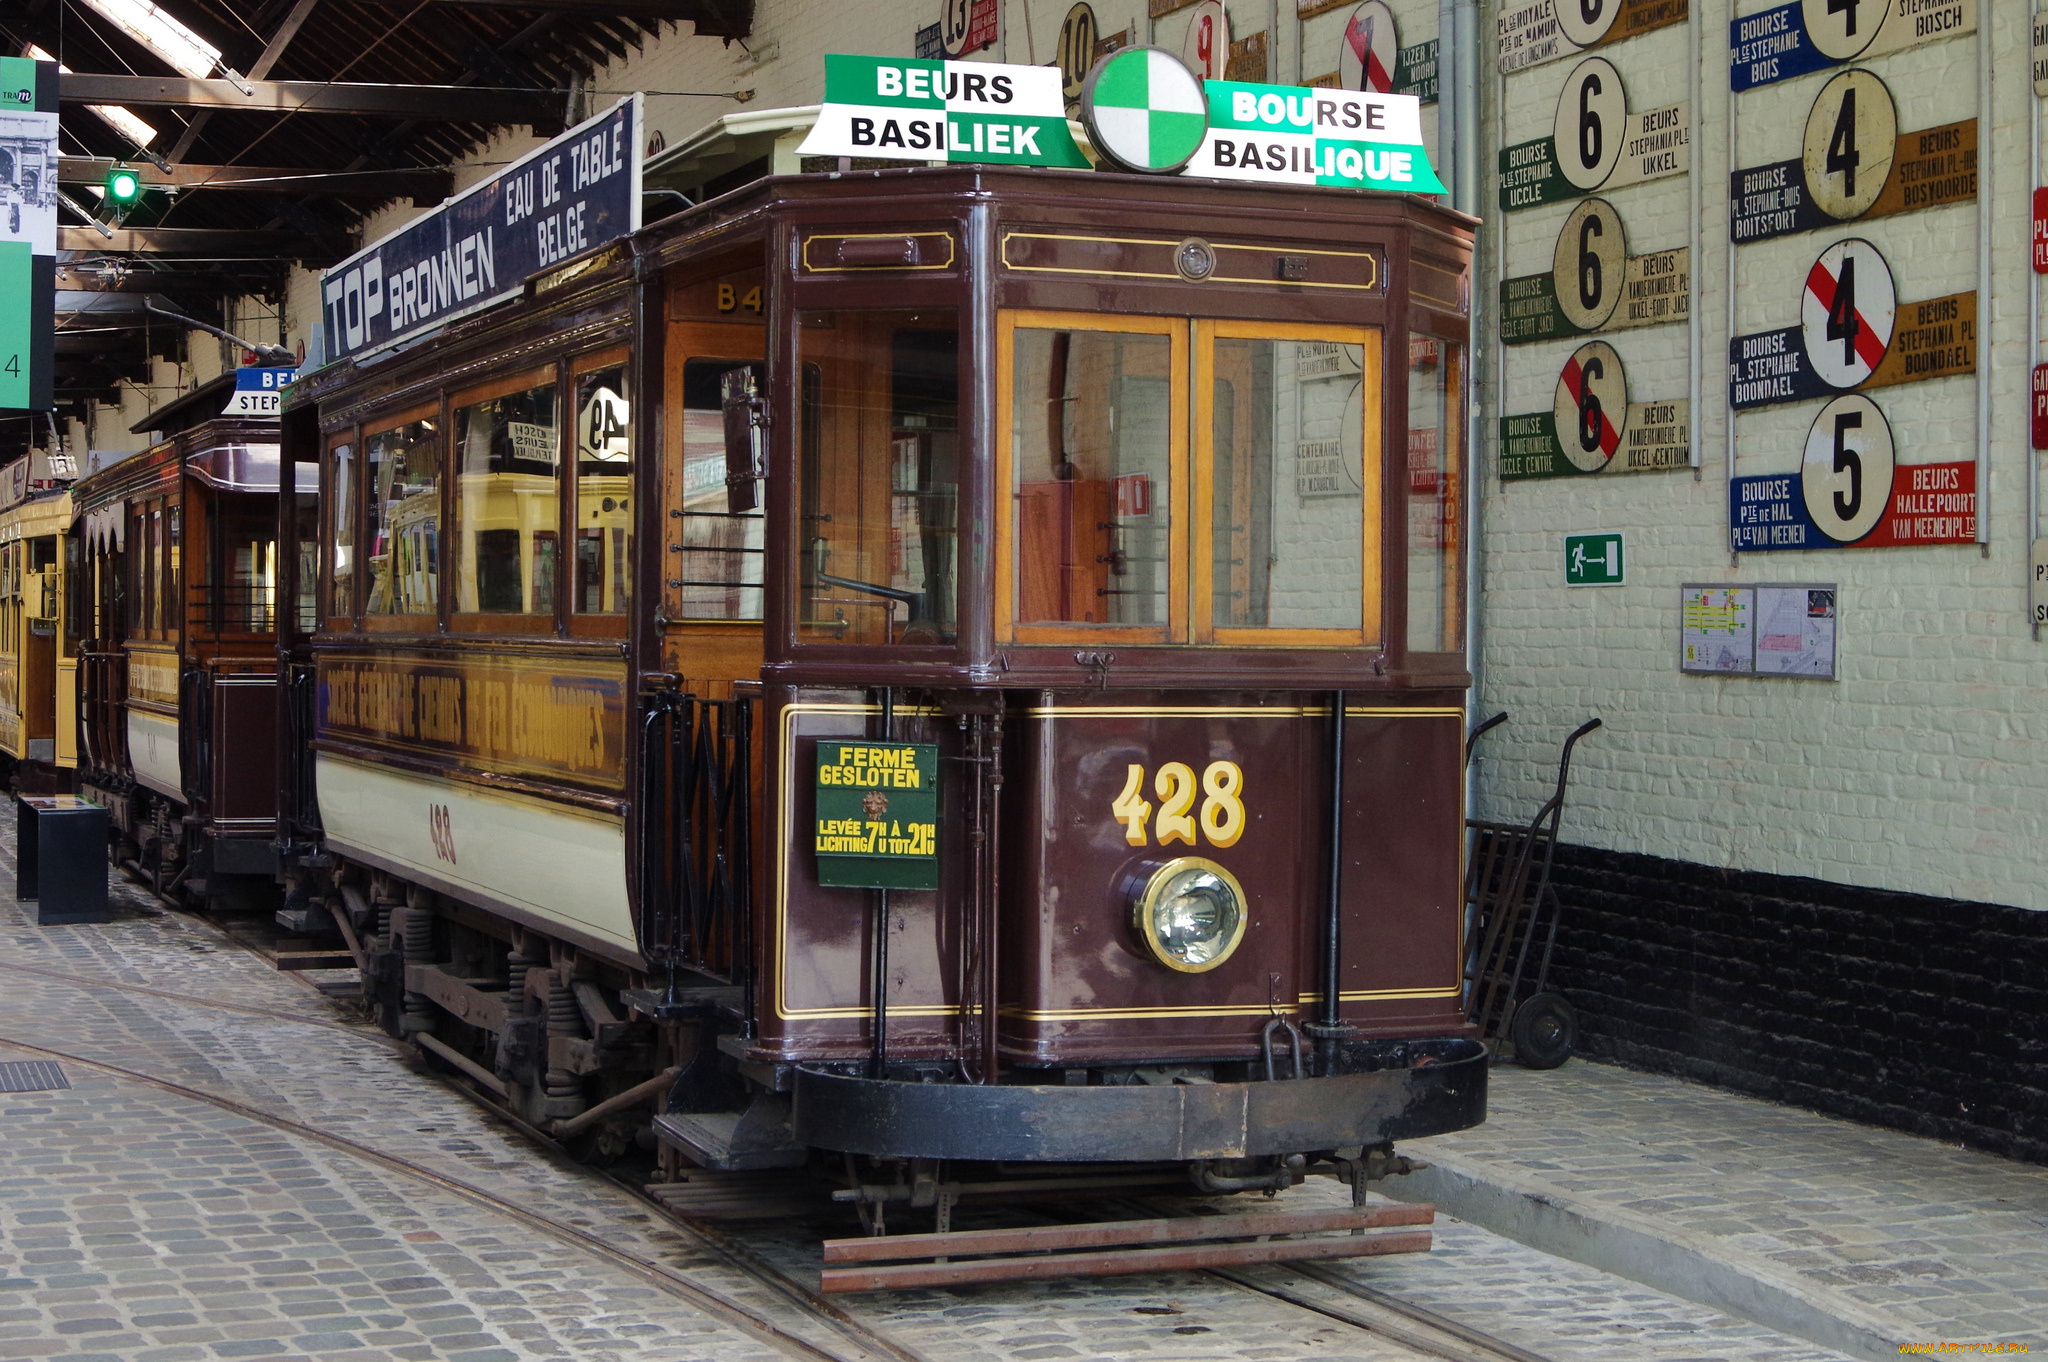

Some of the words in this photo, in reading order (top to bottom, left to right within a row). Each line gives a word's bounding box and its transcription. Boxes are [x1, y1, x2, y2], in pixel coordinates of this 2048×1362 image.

[1517, 1, 1551, 28] ROYALE
[1740, 10, 1789, 42] BOURSE
[1916, 6, 1962, 37] BOSCH
[1514, 34, 1523, 48] DE
[1526, 18, 1556, 44] NAMUR
[1751, 29, 1800, 60] STEPHANIE
[1062, 12, 1089, 88] 10
[1197, 14, 1213, 80] 9
[1357, 15, 1375, 92] 7
[1411, 61, 1436, 83] NOORD
[1751, 58, 1779, 84] BOIS
[876, 66, 1014, 104] BEURS
[1232, 90, 1386, 130] BOURSE
[1579, 73, 1603, 170] 6
[1642, 108, 1679, 134] BEURS
[851, 117, 1042, 156] BASILIEK
[1629, 132, 1672, 157] STEPHANIA
[1827, 88, 1859, 198] 4
[1919, 128, 1960, 156] BEURS
[1214, 139, 1413, 182] BASILIQUE
[1509, 142, 1547, 168] BOURSE
[1642, 151, 1678, 176] UKKEL
[506, 169, 534, 226] EAU
[542, 155, 561, 208] DE
[570, 121, 623, 193] TABLE
[1514, 161, 1553, 186] STEPHANIE
[1744, 166, 1787, 194] BOURSE
[1900, 156, 1945, 184] STEPHANIA
[1510, 184, 1542, 207] UCCLE
[537, 200, 588, 267] BELGE
[1736, 209, 1796, 239] BOITSFORT
[1579, 214, 1603, 311] 6
[1643, 255, 1675, 276] BEURS
[389, 225, 496, 332] BRONNEN
[1508, 278, 1542, 299] BOURSE
[1629, 275, 1676, 299] VANDERKINDERE
[326, 256, 383, 357] TOP
[1826, 256, 1859, 367] 4
[1917, 299, 1958, 326] BEURS
[1743, 333, 1786, 360] BOURSE
[1900, 327, 1954, 353] STEPHANIA
[4, 354, 21, 378] 4
[1747, 351, 1800, 381] STEPHANIE
[1905, 345, 1971, 376] BOONDAEL
[1735, 377, 1794, 404] BOONDAEL
[1580, 357, 1603, 452] 6
[1644, 405, 1675, 425] BEURS
[1508, 417, 1542, 437] BOURSE
[1629, 426, 1675, 447] VANDERKINDERE
[1526, 455, 1554, 476] CENTRE
[1628, 448, 1651, 467] UKKEL
[1833, 411, 1862, 521] 5
[1742, 479, 1790, 502] BOURSE
[1913, 468, 1959, 490] BEURS
[1759, 508, 1769, 522] DE
[1771, 503, 1793, 521] HAL
[1752, 525, 1768, 545] VAN
[1771, 524, 1805, 545] MEENEN
[1893, 519, 1911, 539] VAN
[839, 746, 916, 769] FERMÉ
[819, 765, 920, 788] GESLOTEN
[1112, 760, 1247, 848] 428
[819, 817, 861, 836] LEVÉE
[891, 820, 902, 837] À
[816, 836, 868, 853] LICHTING
[888, 838, 910, 854] TOT
